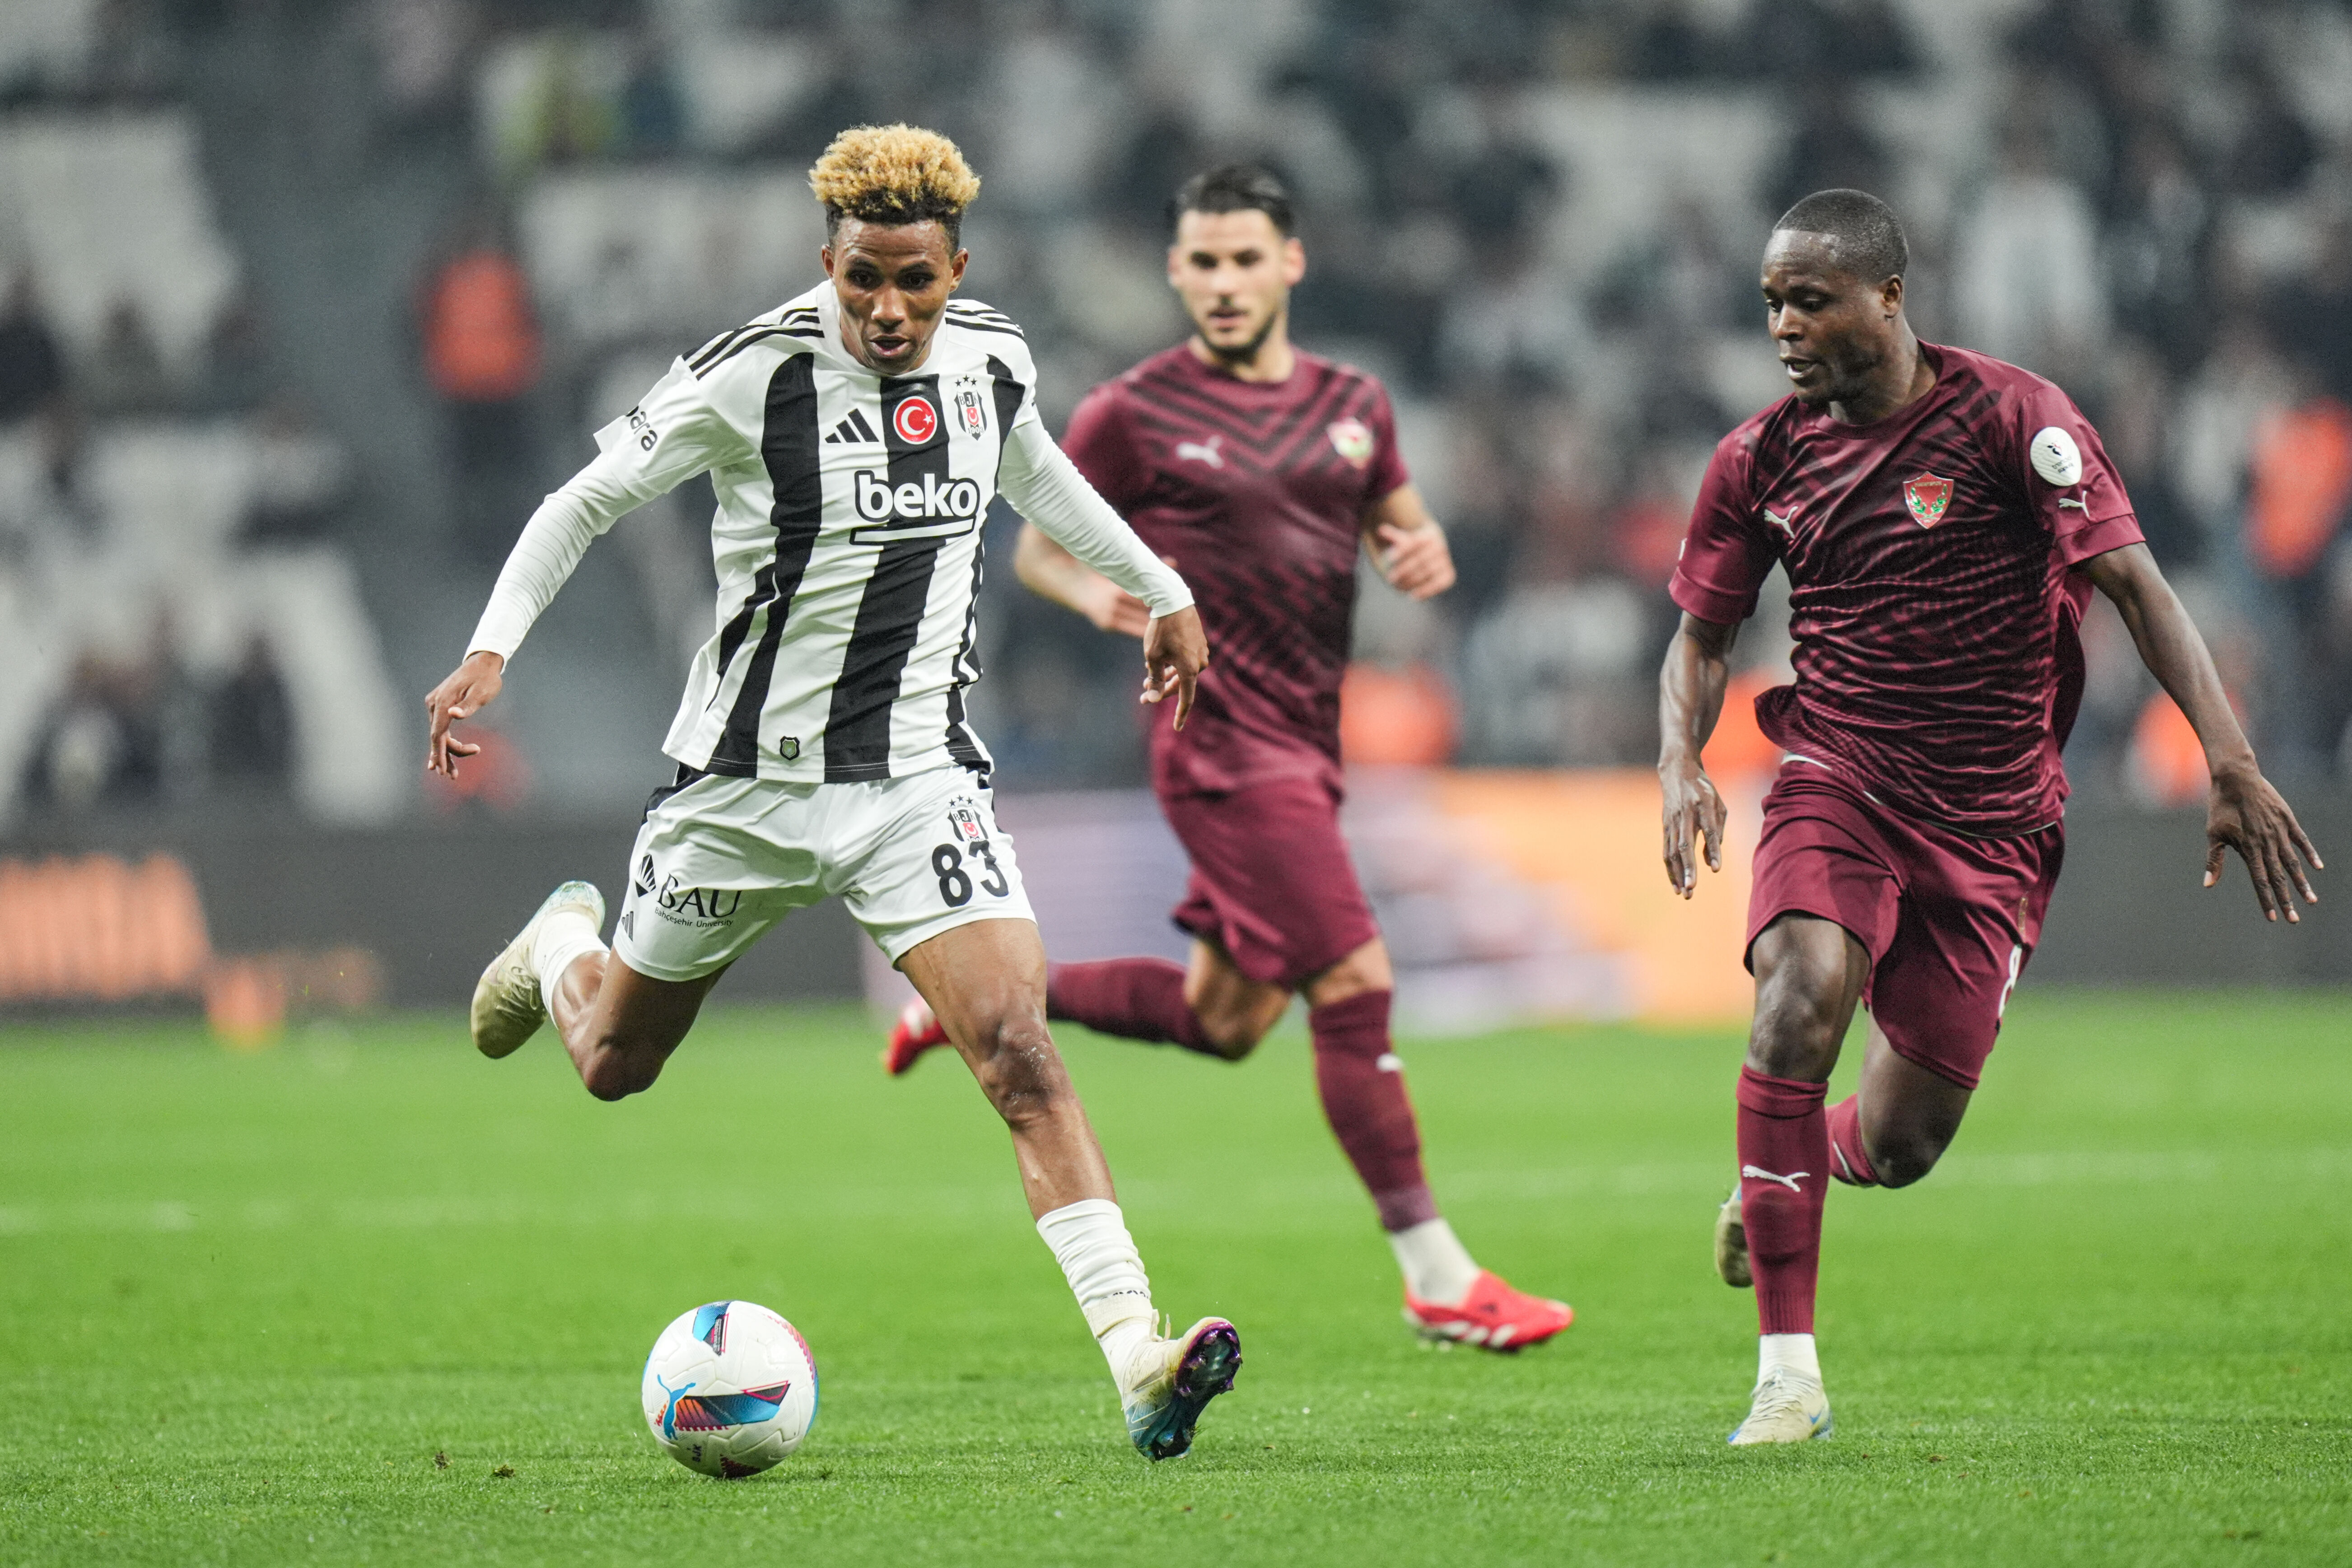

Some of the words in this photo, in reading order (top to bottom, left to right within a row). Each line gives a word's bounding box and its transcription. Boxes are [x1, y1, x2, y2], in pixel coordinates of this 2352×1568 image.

[959, 394, 979, 406] BJK
[967, 426, 984, 434] 1903
[857, 472, 978, 519] beko
[952, 812, 977, 821] BJK
[932, 840, 1009, 908] 83
[656, 872, 743, 918] BAU
[654, 906, 693, 927] Bahçeşehir
[696, 919, 734, 928] University
